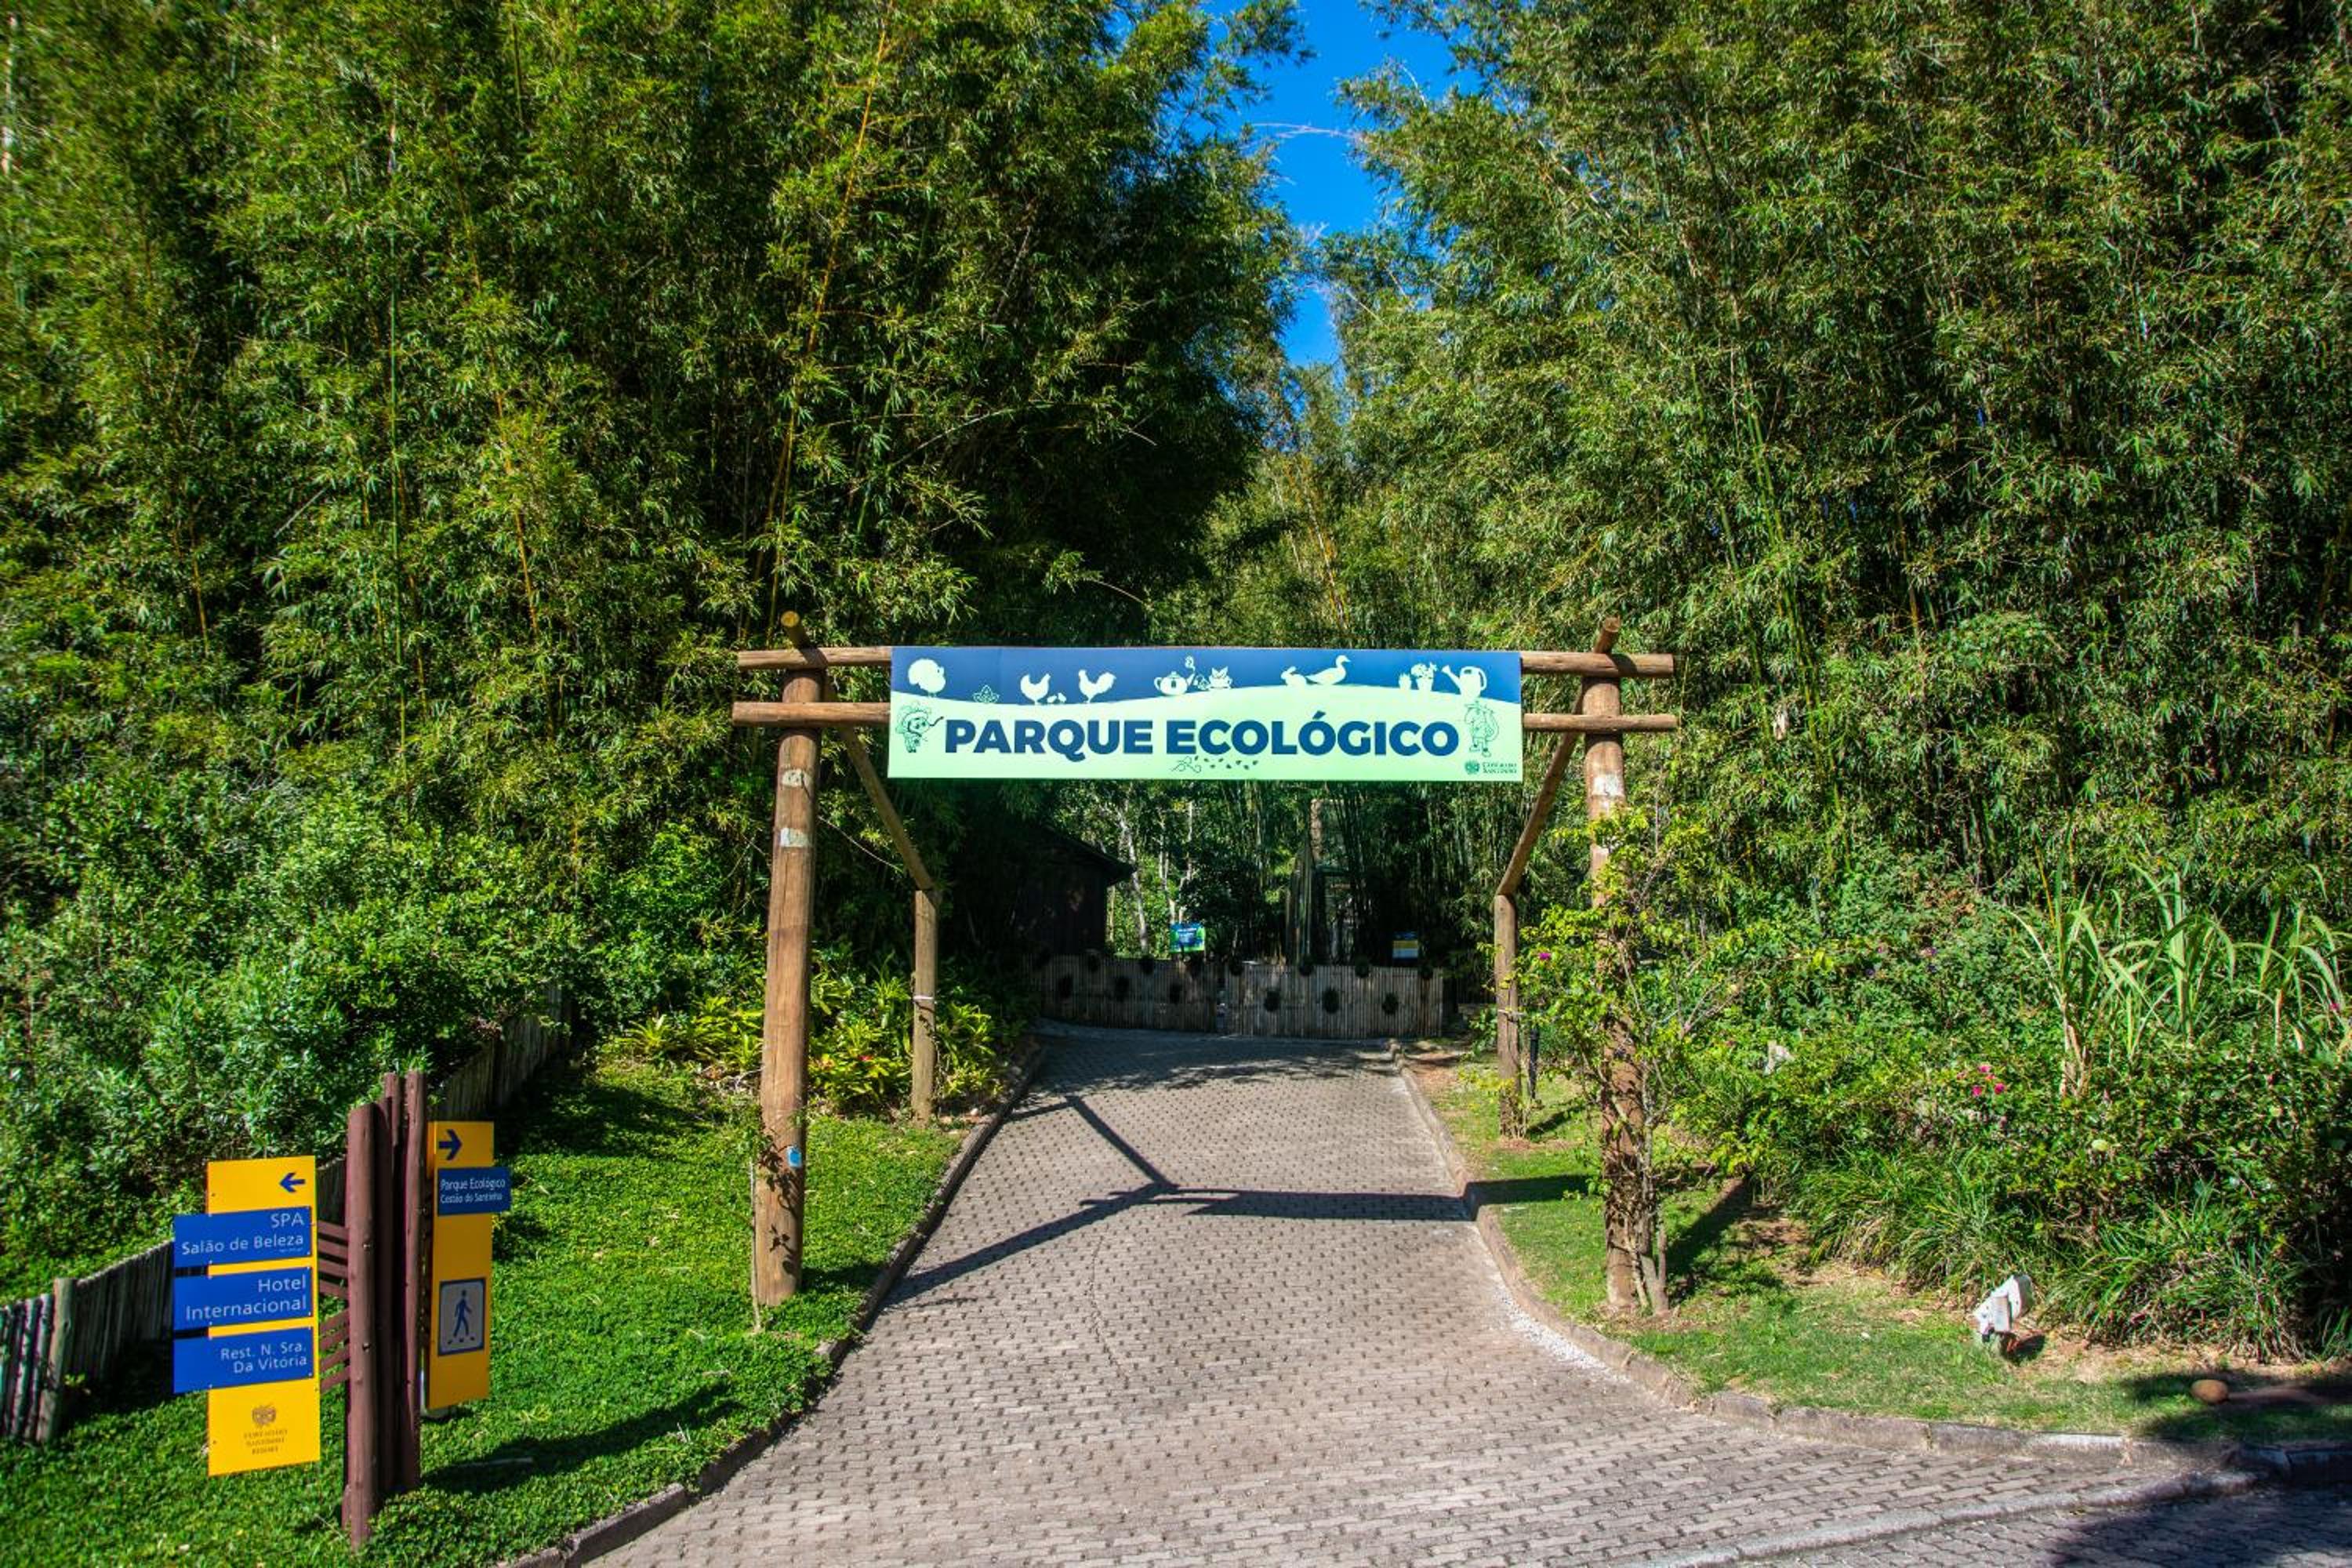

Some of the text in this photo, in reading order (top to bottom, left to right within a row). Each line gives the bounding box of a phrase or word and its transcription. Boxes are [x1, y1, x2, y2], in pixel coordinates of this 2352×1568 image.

[946, 710, 1459, 762] PARQUE ECOLÓGICO
[441, 1178, 506, 1192] Parque Ecológico
[270, 1212, 304, 1229] SPA
[182, 1233, 303, 1255] Salão de Beleza
[258, 1274, 307, 1293] Hotel
[186, 1294, 307, 1320] Internacional
[220, 1341, 307, 1360] Rest. N. Sra.
[234, 1360, 253, 1374] Da
